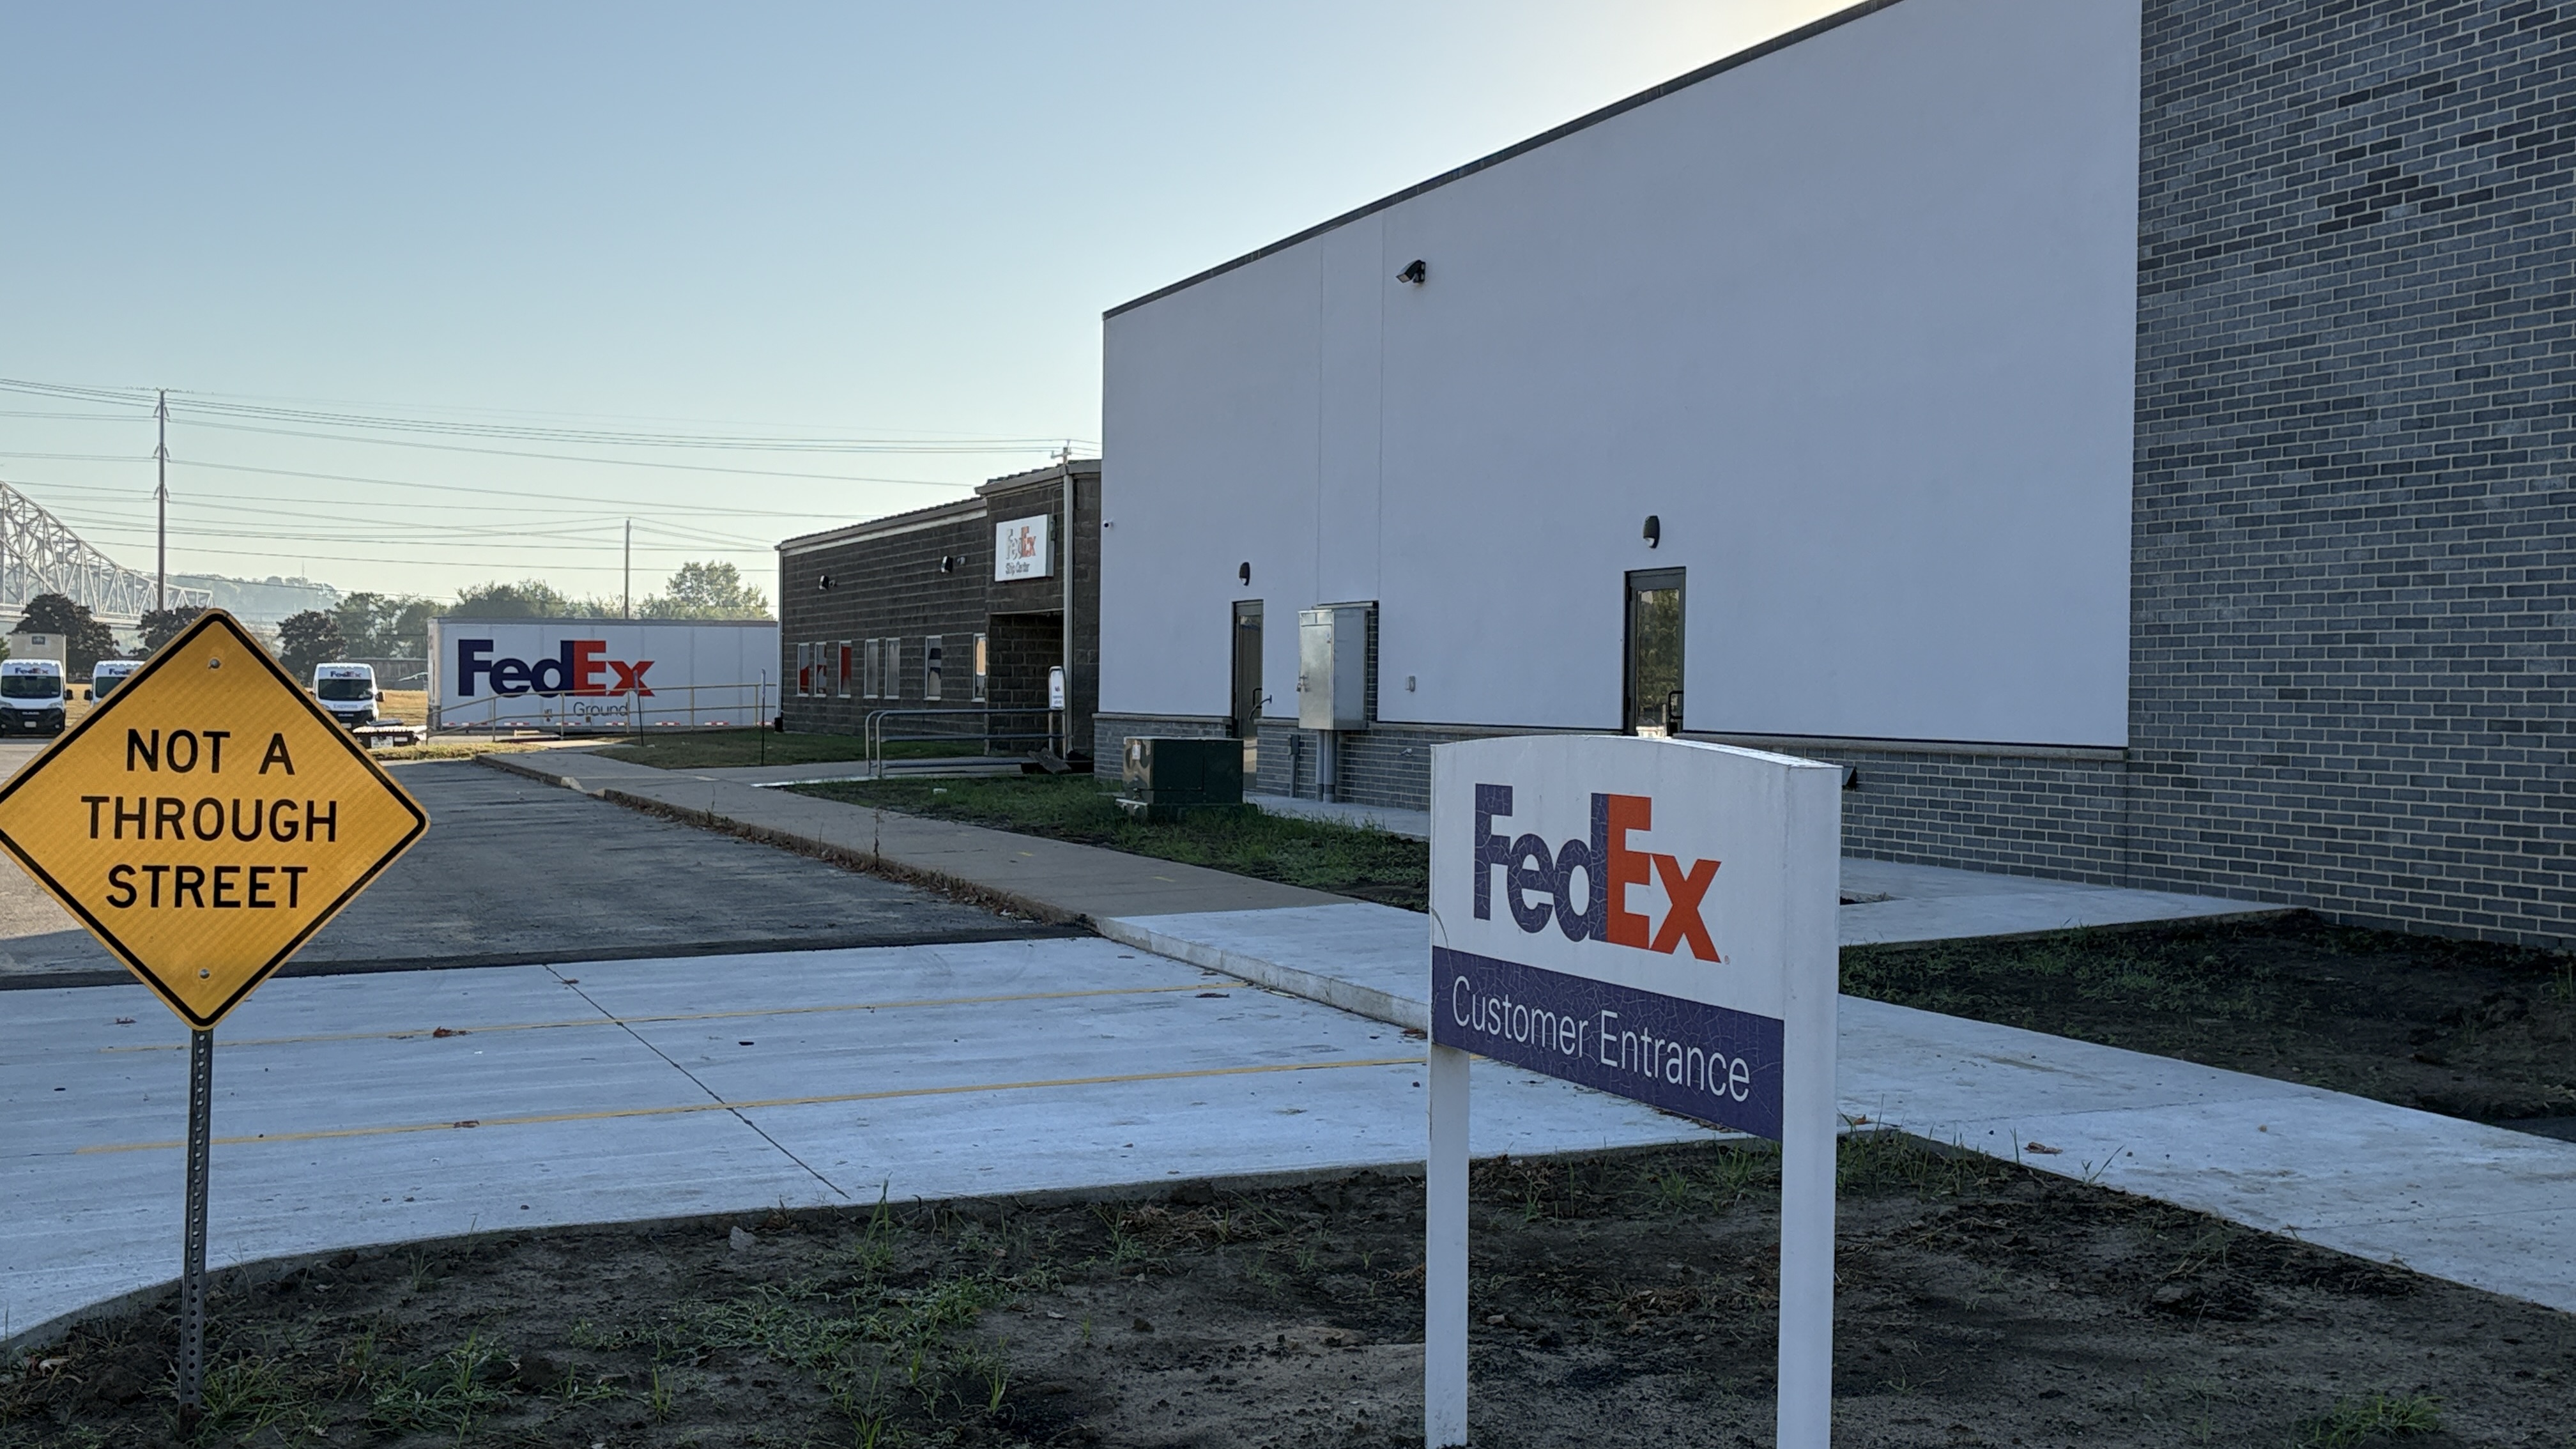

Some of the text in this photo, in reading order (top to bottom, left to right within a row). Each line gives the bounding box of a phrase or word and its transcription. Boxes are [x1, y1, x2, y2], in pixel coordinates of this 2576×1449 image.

[458, 639, 656, 698] FedEx
[573, 702, 628, 717] Ground
[127, 728, 295, 775] NOT A
[81, 796, 337, 842] THROUGH
[106, 864, 308, 908] STREET
[1474, 783, 1722, 963] FedEx
[1452, 976, 1750, 1101] Customer Entrance
